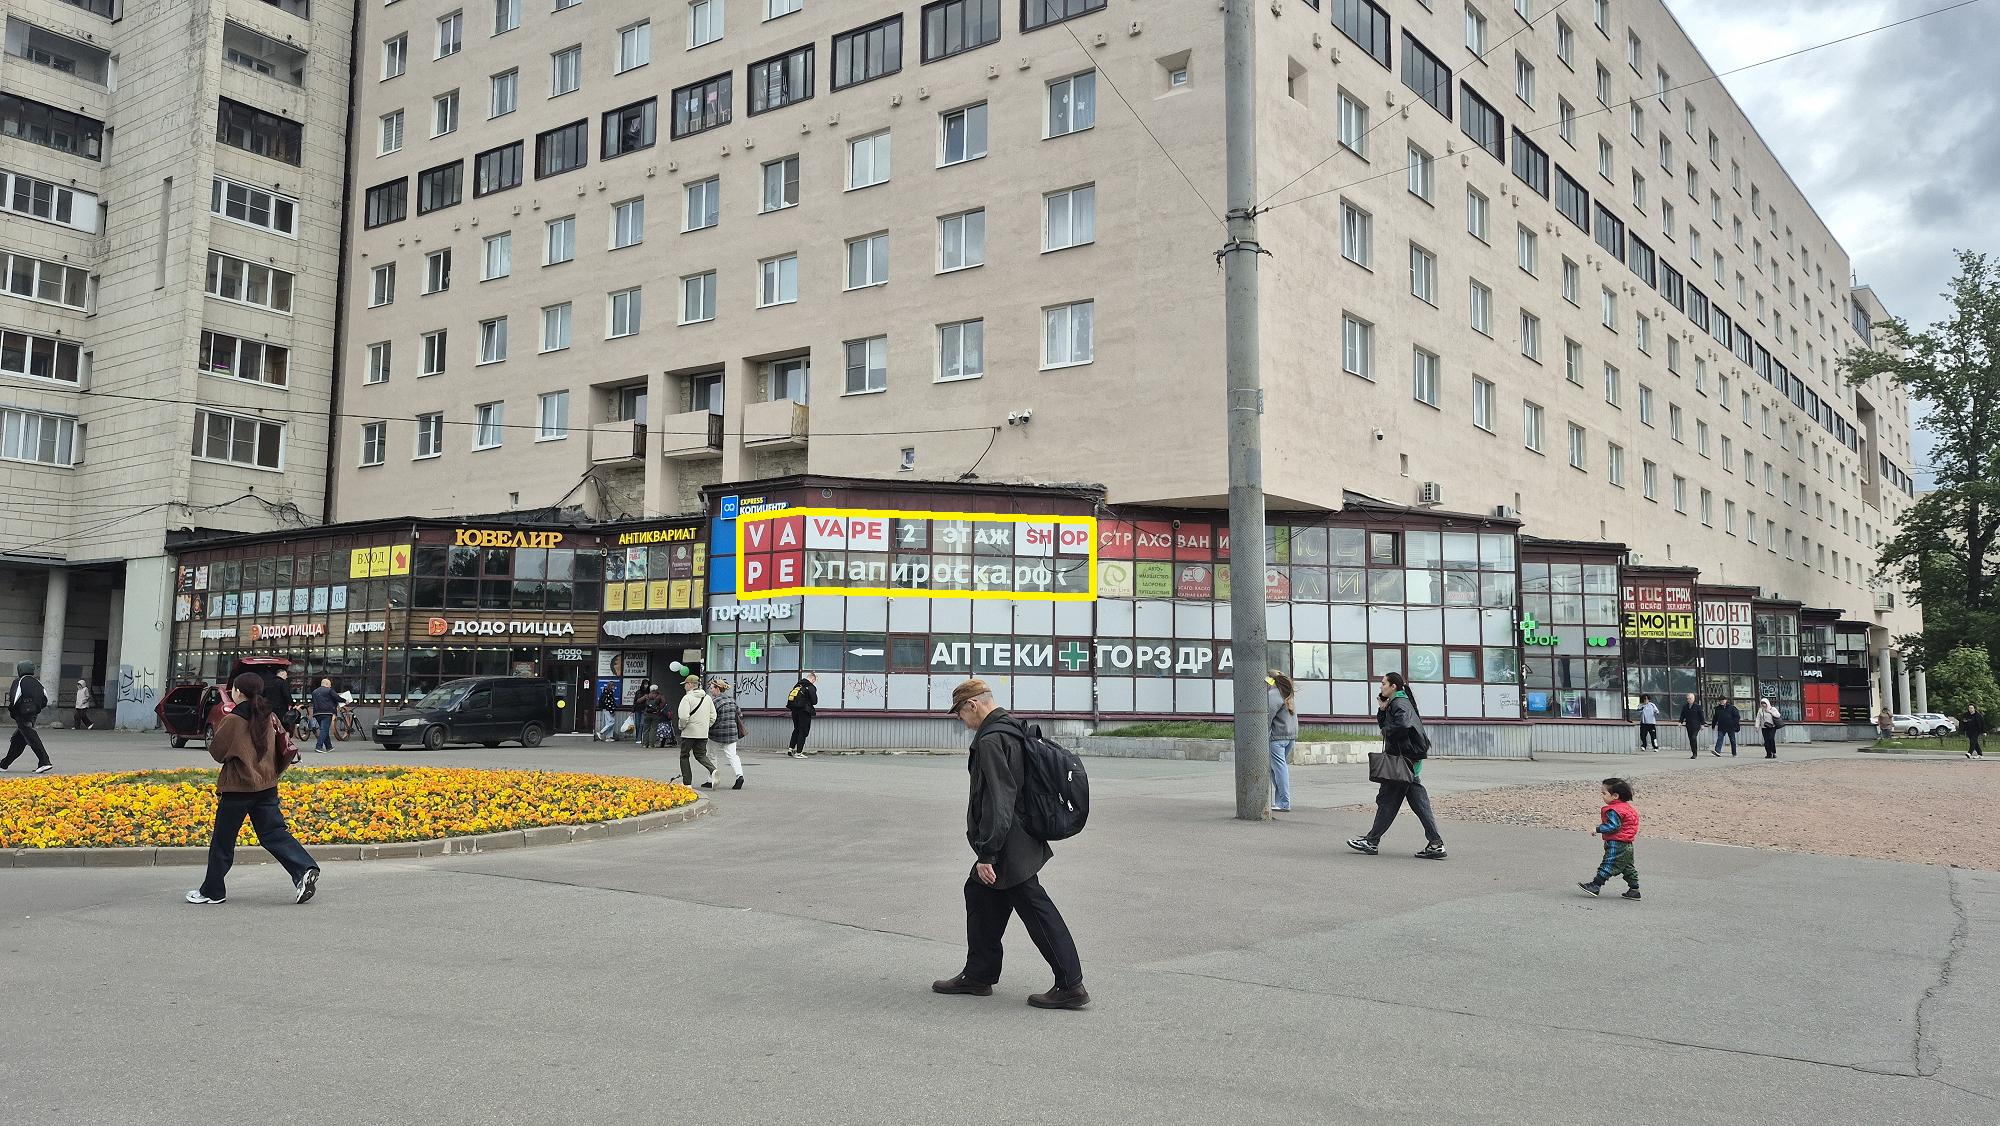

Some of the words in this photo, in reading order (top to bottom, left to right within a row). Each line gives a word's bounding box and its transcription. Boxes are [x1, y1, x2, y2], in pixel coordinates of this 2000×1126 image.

[740, 497, 764, 506] EXPRESS
[740, 502, 787, 516] КОПИЦЕНТР
[455, 528, 563, 549] ЮВЕЛИР
[618, 527, 697, 545] АНТИКВАРИАТ
[813, 518, 882, 540] VAPE
[903, 524, 916, 543] 2
[942, 527, 1010, 545] ЭТАЖ
[1026, 528, 1089, 546] SHOP
[1100, 530, 1230, 549] СТРАХОВАНИ
[357, 551, 385, 565] ВХОД
[334, 592, 344, 603] 03
[710, 603, 792, 622] ГОРЗДРАВ
[1626, 613, 1692, 629] ЕМОНТ
[1704, 603, 1750, 622] МОНТ
[261, 625, 287, 640] ДОДО
[288, 623, 323, 638] ПИЦЦА
[451, 620, 506, 635] ДОДО
[509, 621, 575, 637] ПИЦЦА
[1706, 627, 1740, 646] СОВ
[930, 642, 1053, 667] АПТЕКИ
[1096, 645, 1233, 674] ГОРЗДРА
[1416, 655, 1432, 666] 24
